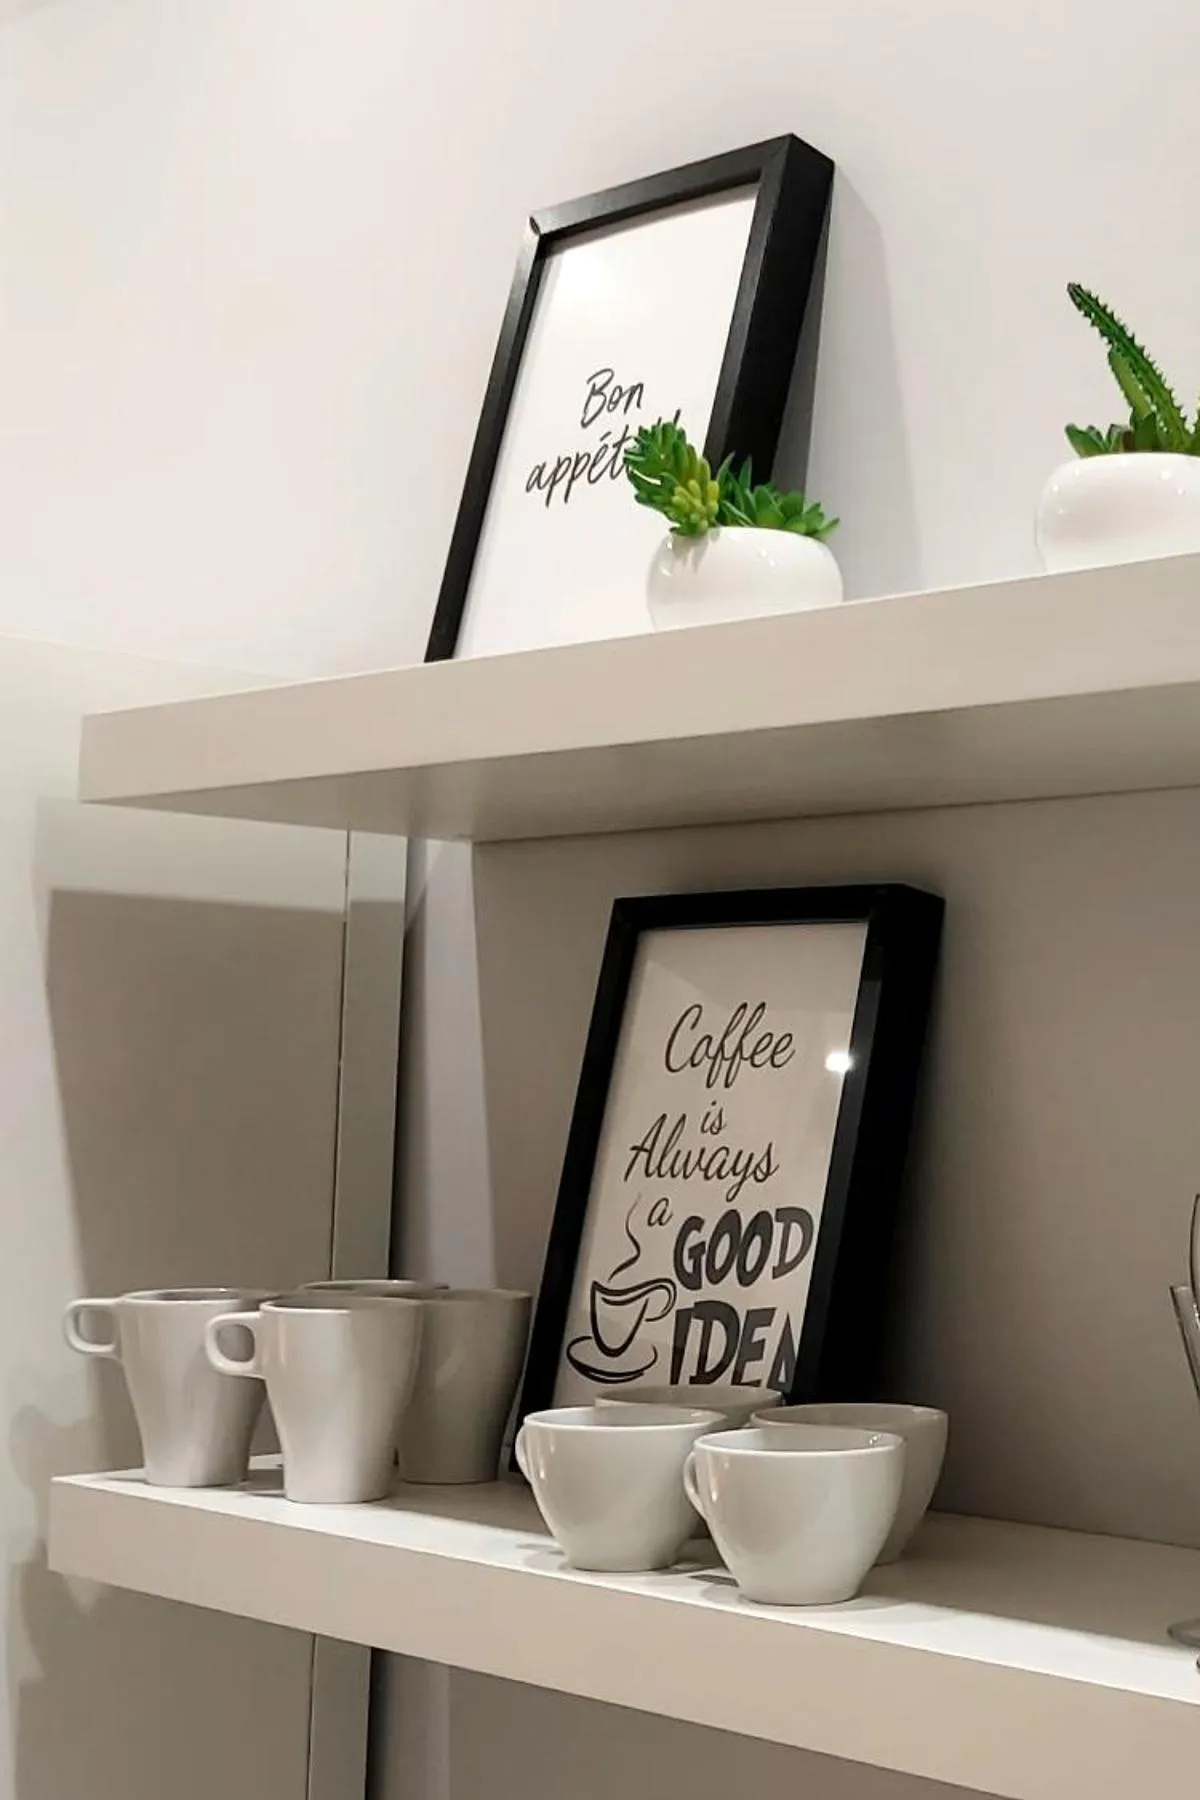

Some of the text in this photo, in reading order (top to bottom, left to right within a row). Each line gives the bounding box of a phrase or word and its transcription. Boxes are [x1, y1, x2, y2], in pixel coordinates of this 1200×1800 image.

[580, 367, 645, 430] Bon
[664, 1000, 797, 1090] Coffee
[623, 1112, 780, 1203] Always
[700, 1100, 728, 1136] is
[647, 1196, 815, 1291] a GOOD
